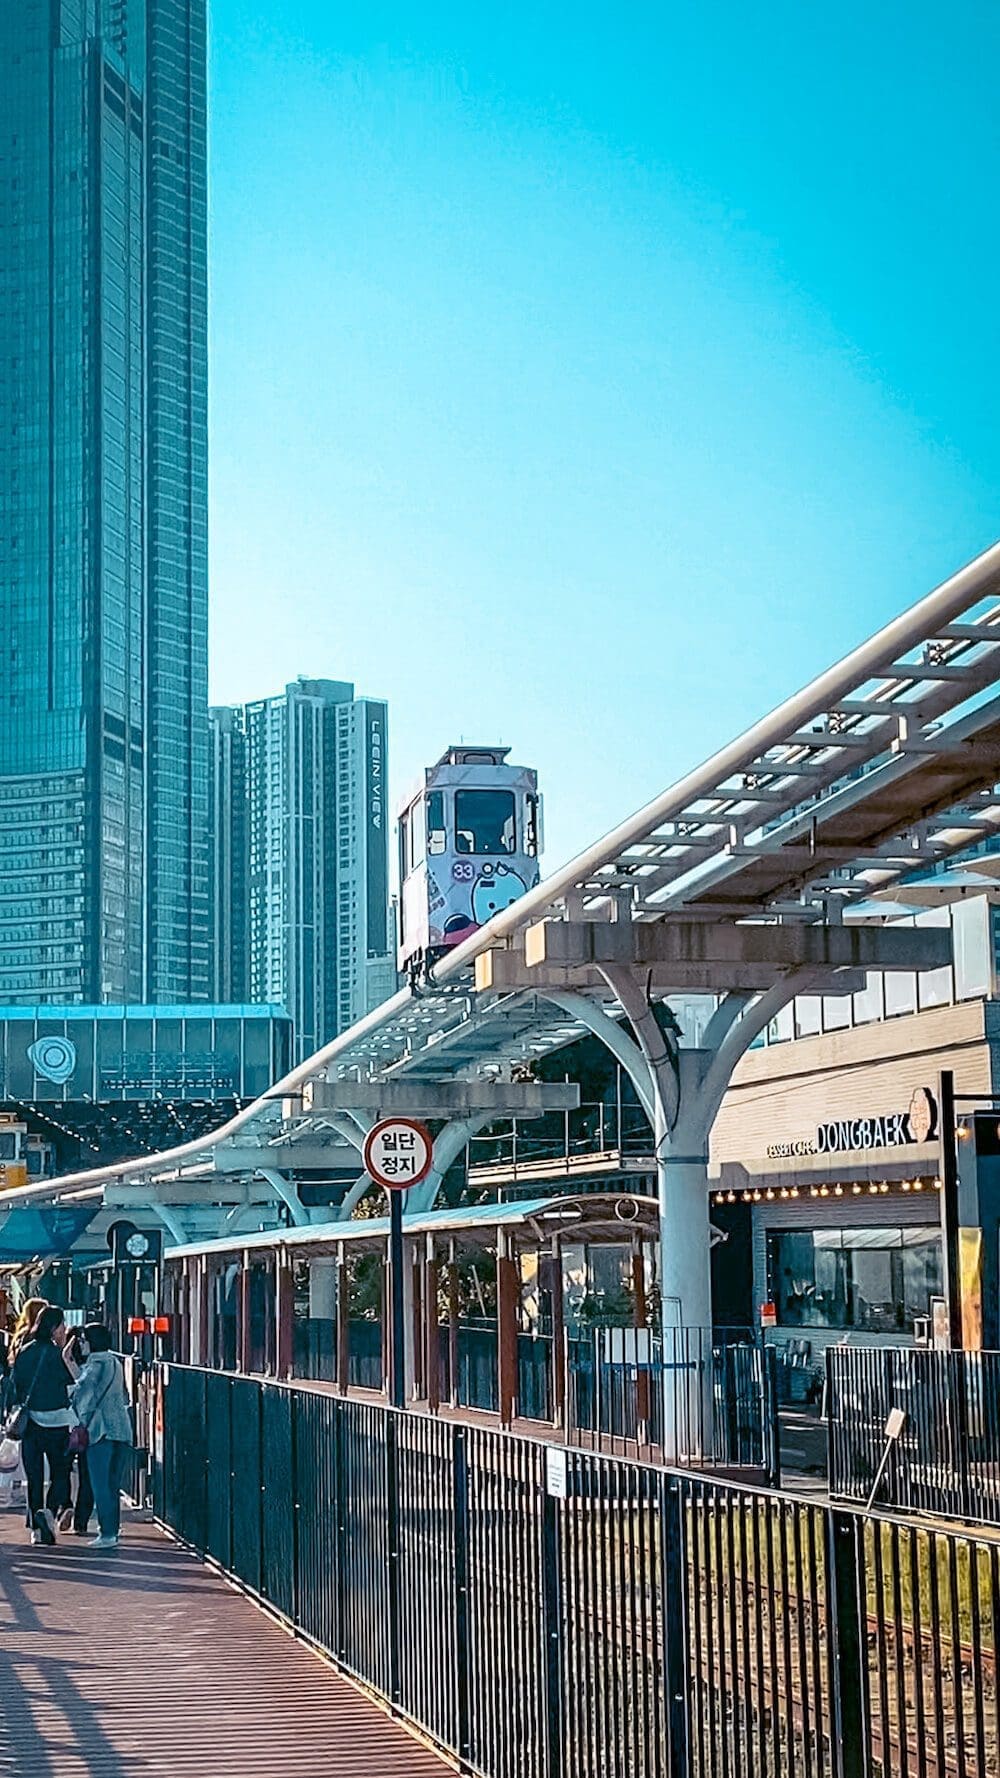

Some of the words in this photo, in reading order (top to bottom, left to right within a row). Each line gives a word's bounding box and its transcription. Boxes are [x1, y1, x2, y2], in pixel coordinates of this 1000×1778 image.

[372, 783, 381, 829] VIEW
[453, 863, 473, 879] 33
[381, 1132, 416, 1151] 일단
[816, 1114, 908, 1154] DONGBAEK
[381, 1156, 416, 1175] 정지
